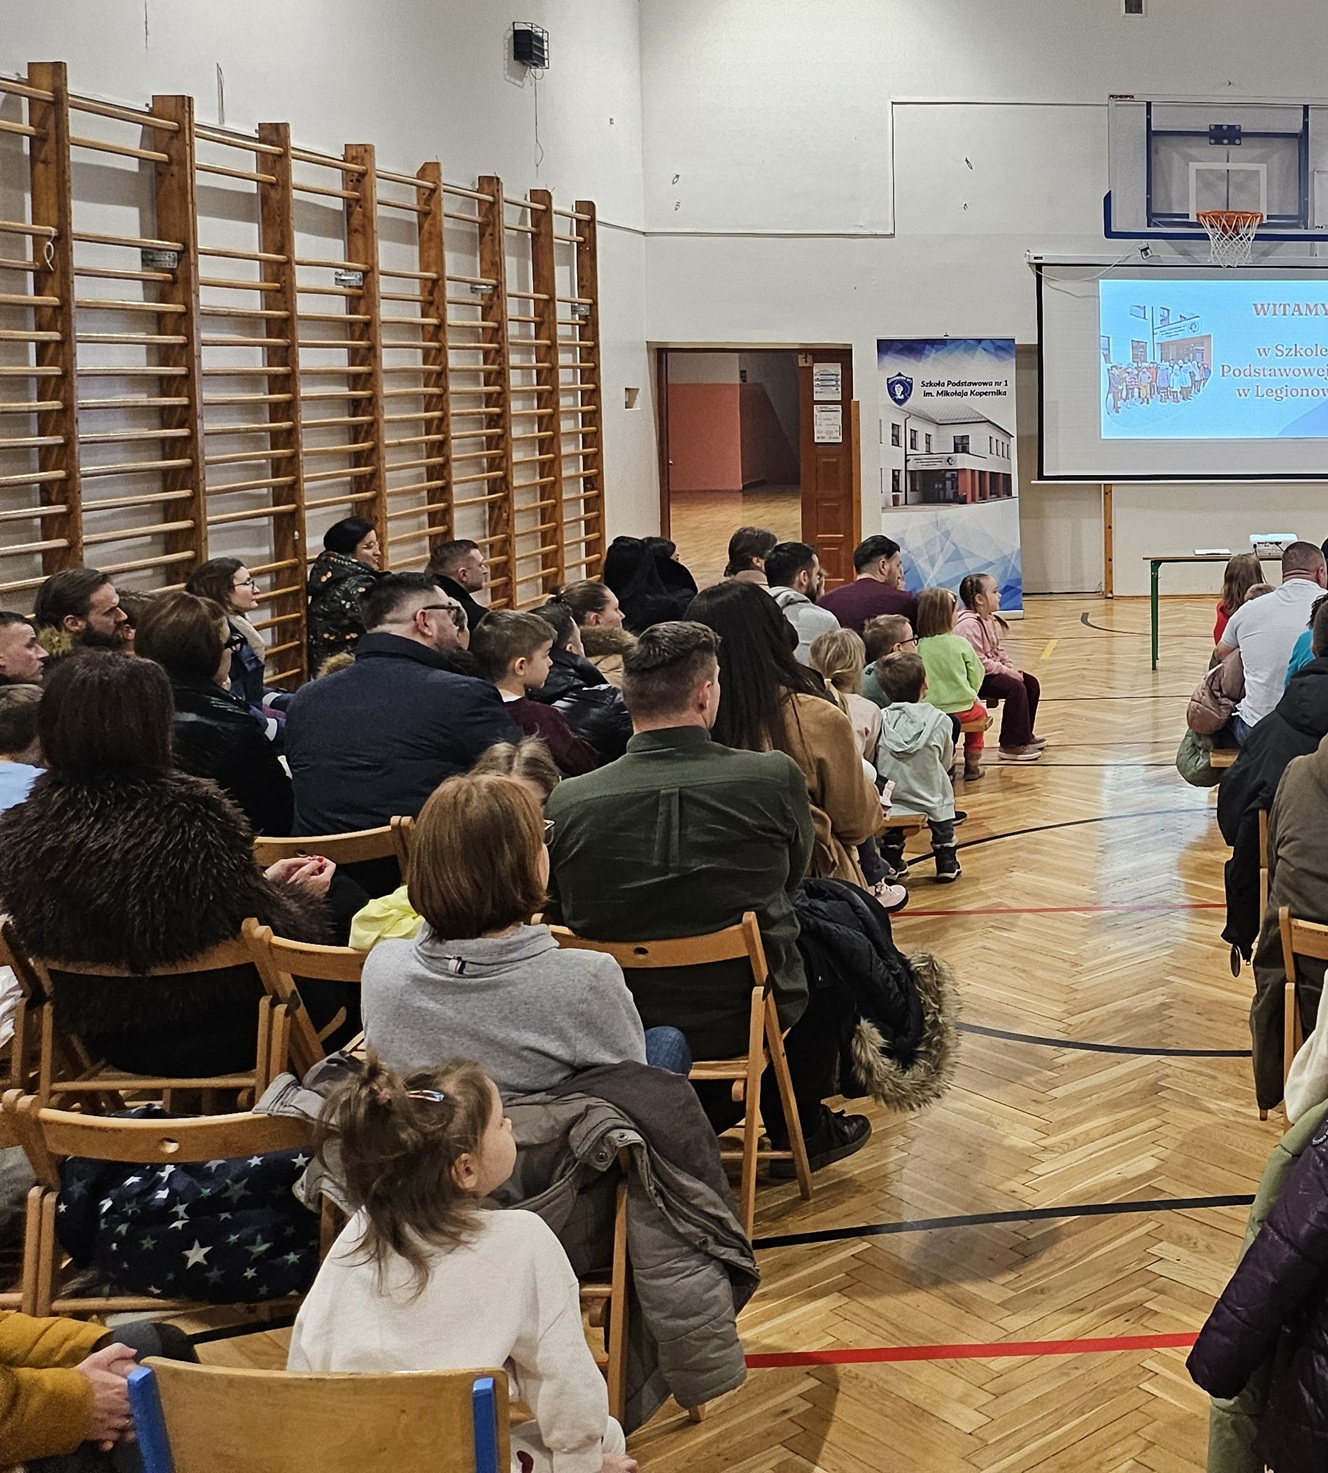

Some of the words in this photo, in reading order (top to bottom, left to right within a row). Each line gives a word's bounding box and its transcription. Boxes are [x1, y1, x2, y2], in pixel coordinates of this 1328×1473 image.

[1257, 347, 1271, 357] w
[1275, 343, 1328, 357] Szkole
[1003, 379, 1008, 387] 1
[936, 389, 968, 398] Mikołaja
[969, 389, 1007, 398] Kopernika
[1236, 388, 1251, 398] w
